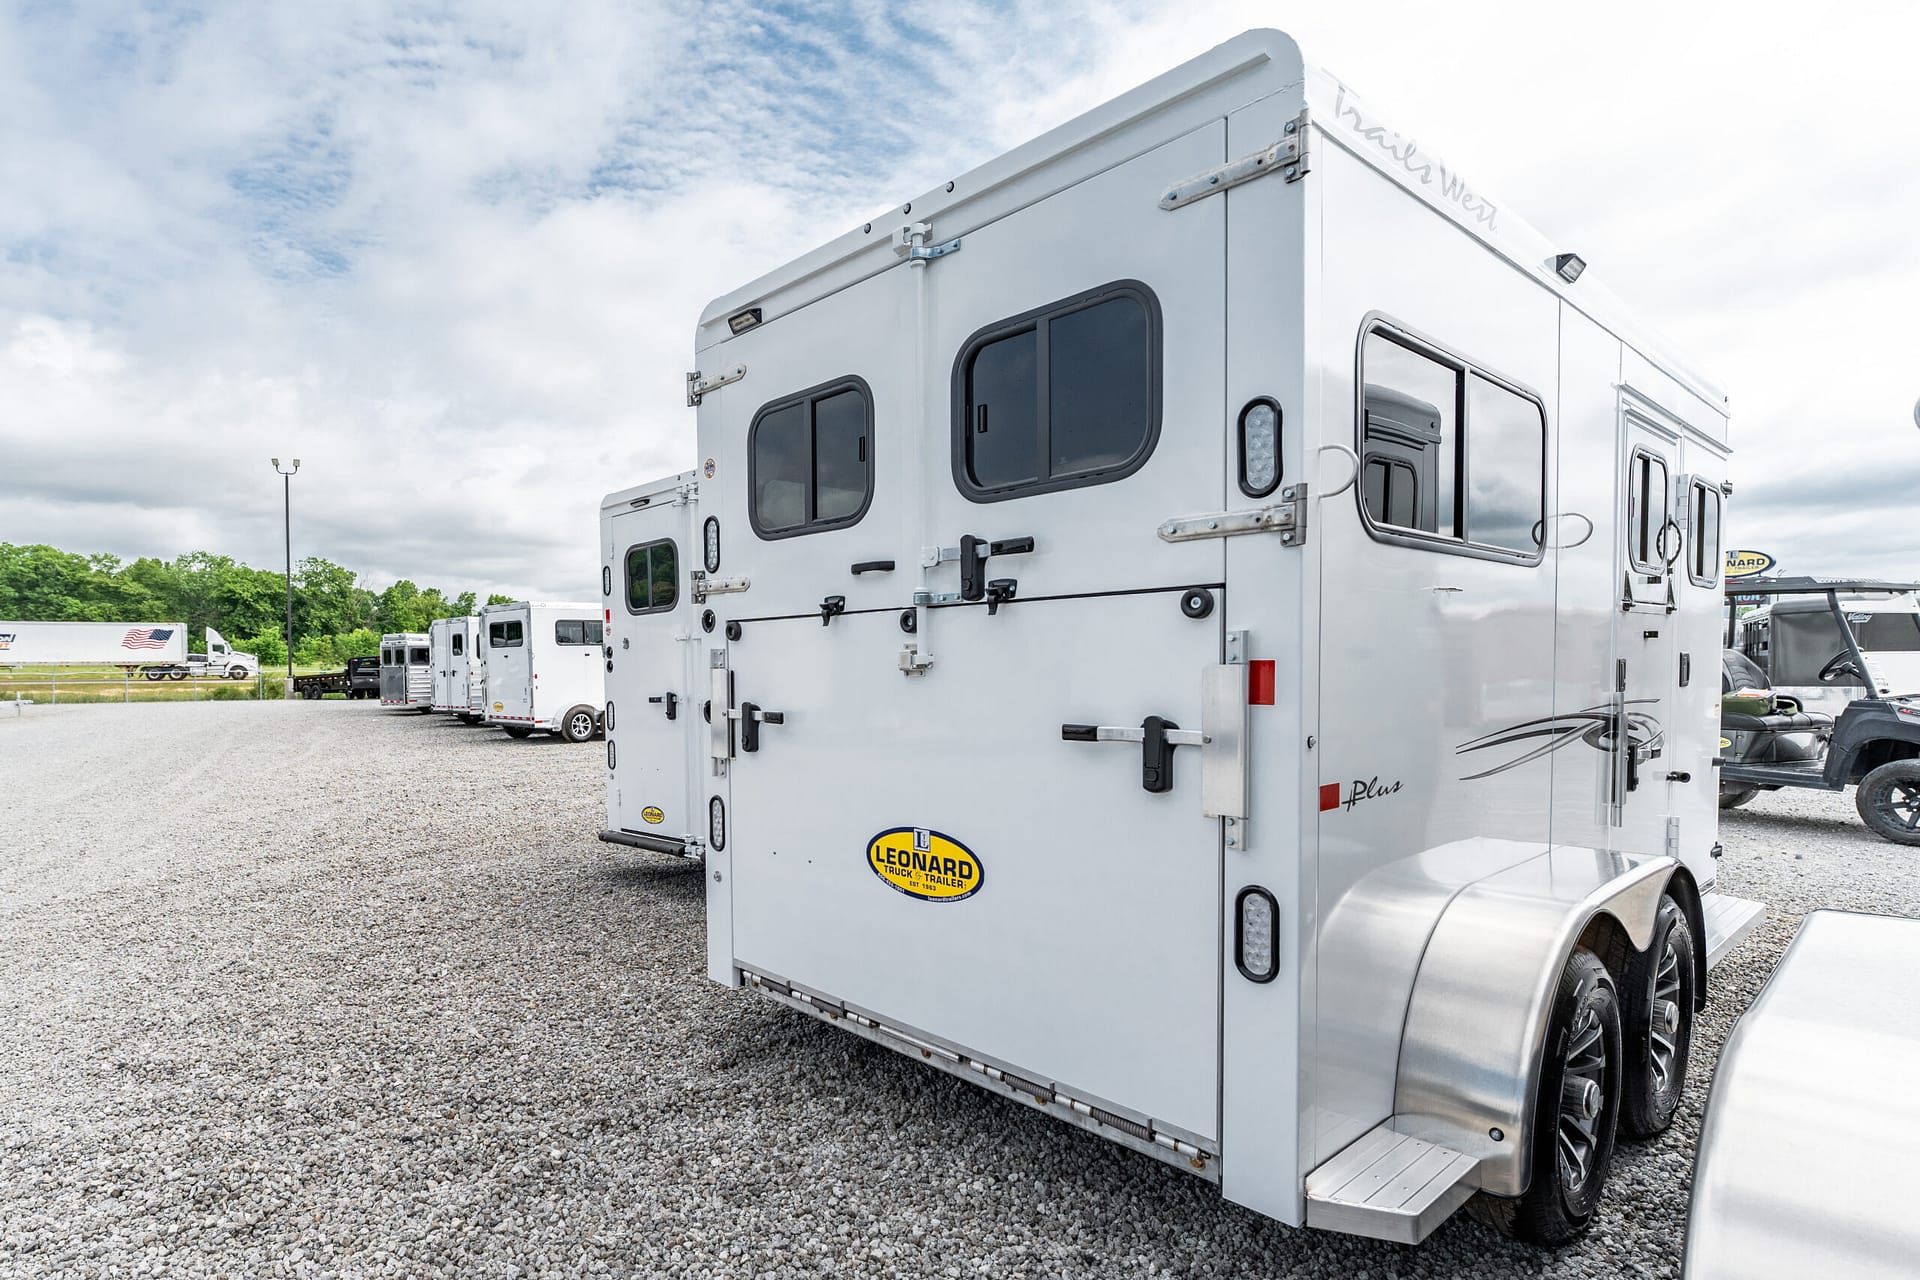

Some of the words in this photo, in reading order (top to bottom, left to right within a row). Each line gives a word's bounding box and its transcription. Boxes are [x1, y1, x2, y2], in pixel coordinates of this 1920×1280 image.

[1335, 84, 1433, 185] Trails
[1439, 163, 1499, 232] West
[1726, 558, 1766, 567] NARD
[875, 845, 973, 880] LEONARD
[884, 865, 913, 879] TRUCK
[924, 873, 964, 889] TRAILER
